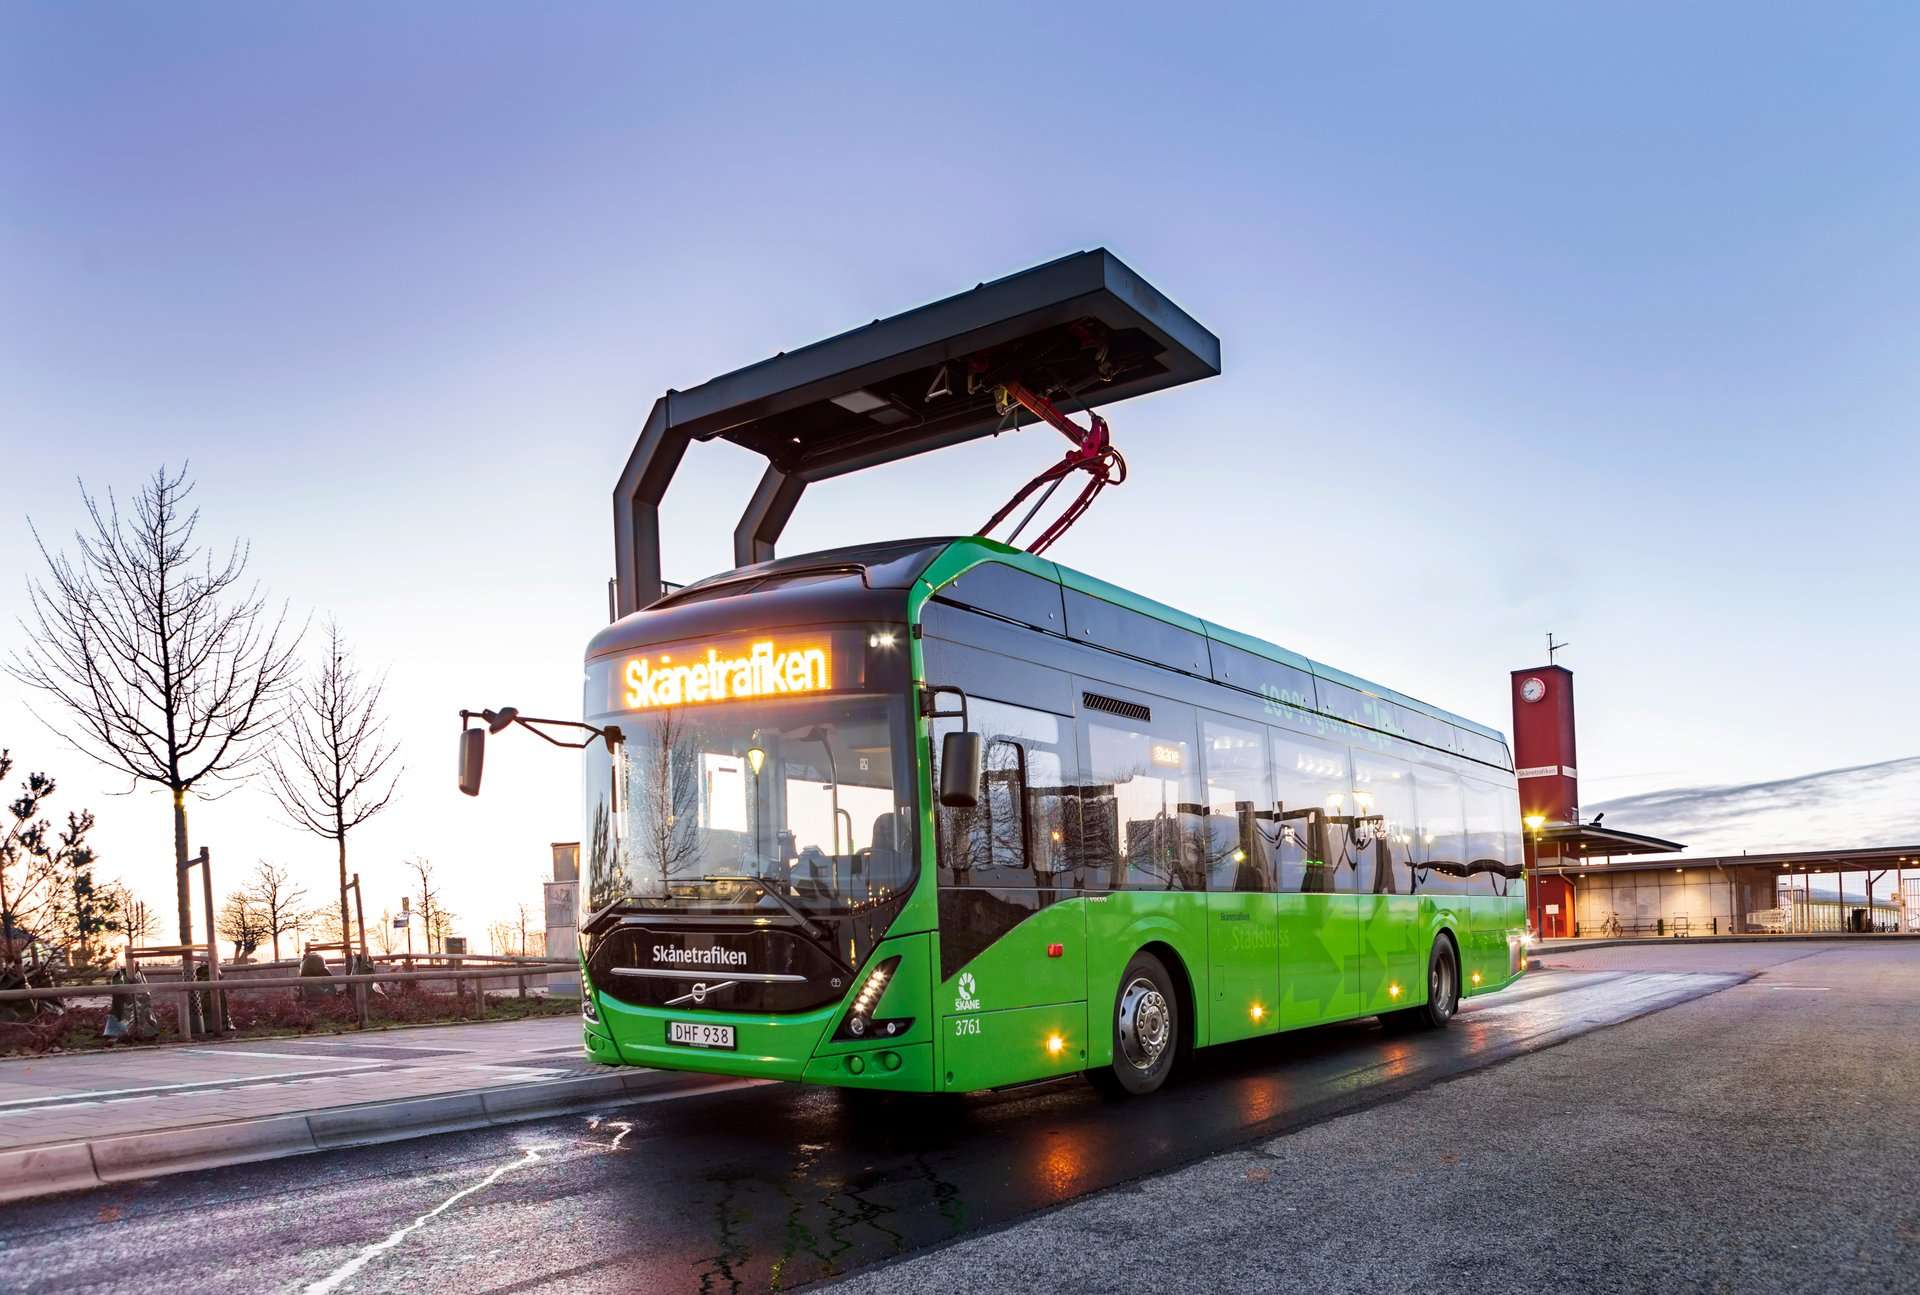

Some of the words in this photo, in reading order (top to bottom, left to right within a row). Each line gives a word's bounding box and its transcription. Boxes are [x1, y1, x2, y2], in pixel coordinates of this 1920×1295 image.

[625, 641, 826, 709] Skånetrafiken
[652, 944, 747, 966] Skånetrafiken
[675, 1024, 699, 1041] DHF
[703, 1027, 729, 1044] 938
[955, 1018, 981, 1036] 3761
